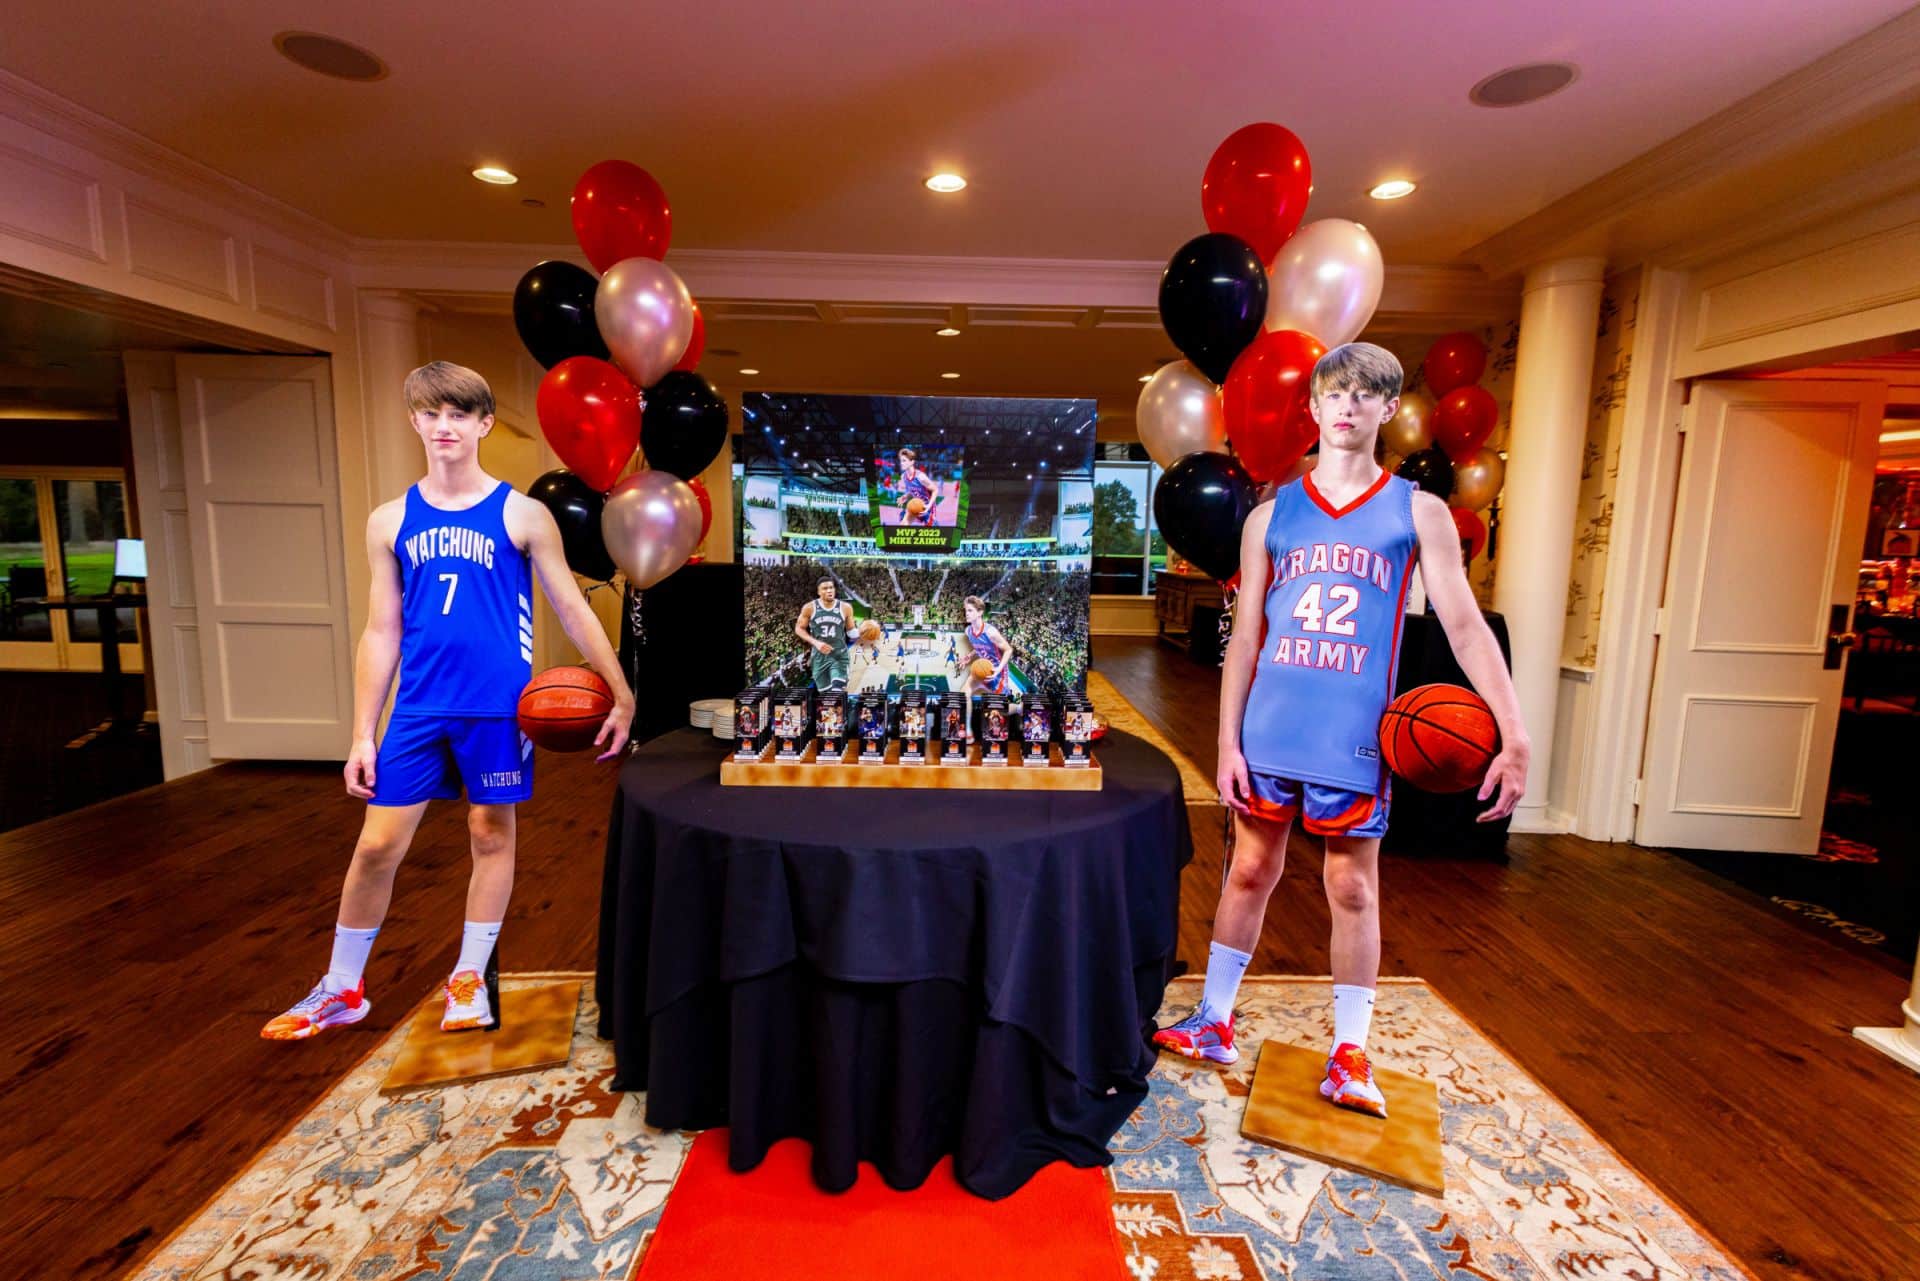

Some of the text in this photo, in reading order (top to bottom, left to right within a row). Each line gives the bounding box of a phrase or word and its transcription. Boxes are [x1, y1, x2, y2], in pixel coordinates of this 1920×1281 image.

[889, 536, 947, 545] MIKE ZAIKOV
[896, 528, 941, 537] MVP 2023
[405, 525, 495, 570] WATCHUNG
[438, 573, 459, 615] 7
[1291, 582, 1360, 637] 42
[820, 625, 836, 638] 34
[1272, 636, 1369, 675] ARMY
[480, 770, 522, 788] WATCHUNG
